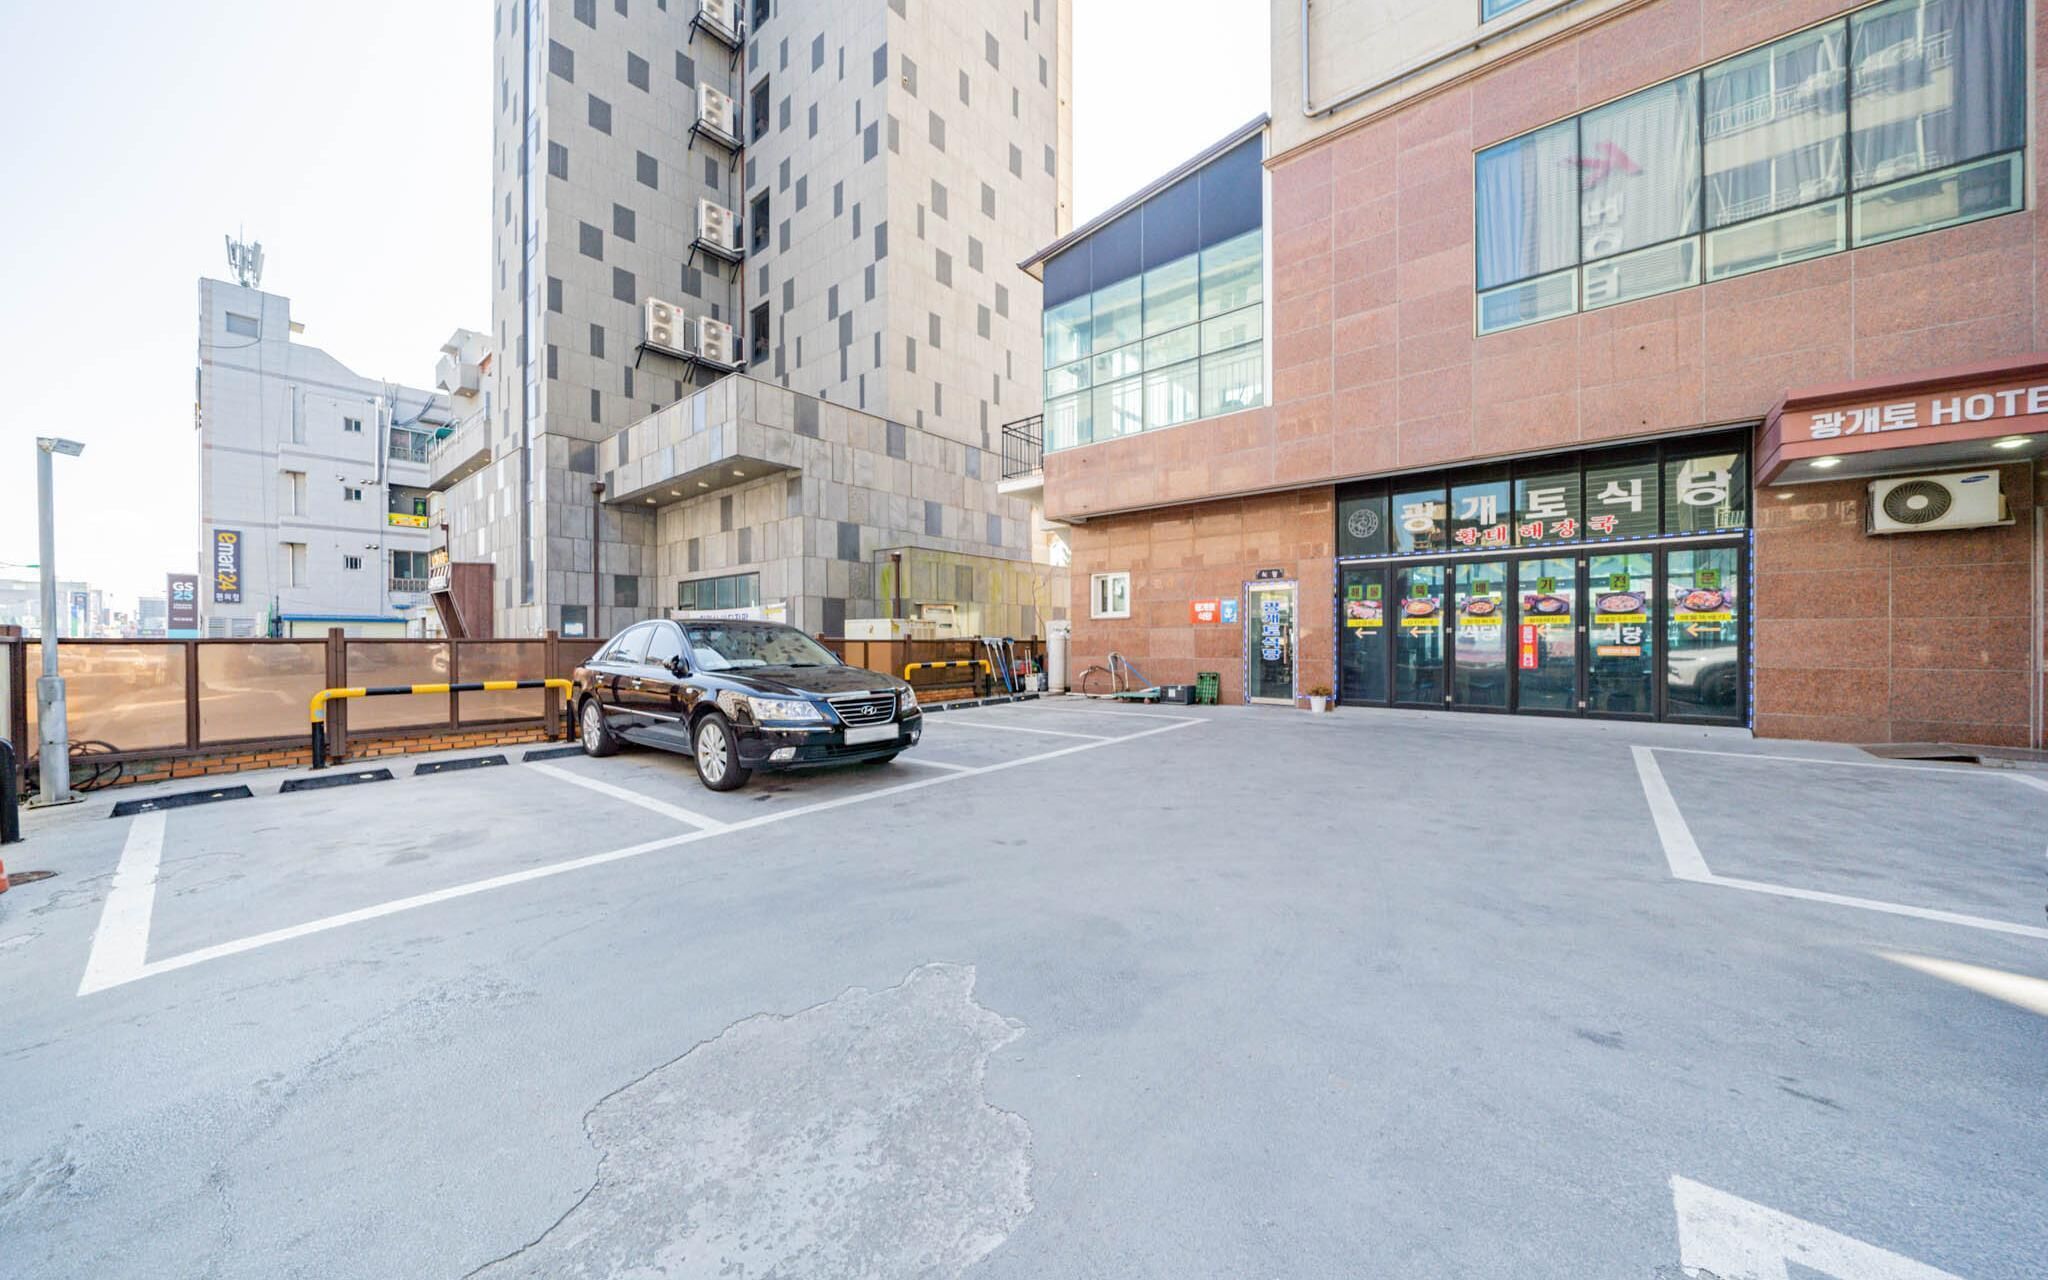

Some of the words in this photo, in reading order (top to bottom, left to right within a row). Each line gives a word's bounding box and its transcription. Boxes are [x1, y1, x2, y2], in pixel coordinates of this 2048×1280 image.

[1809, 402, 1919, 439] 광개토
[1401, 469, 1732, 533] 광개토식당
[173, 582, 194, 592] GS
[173, 591, 194, 601] 25
